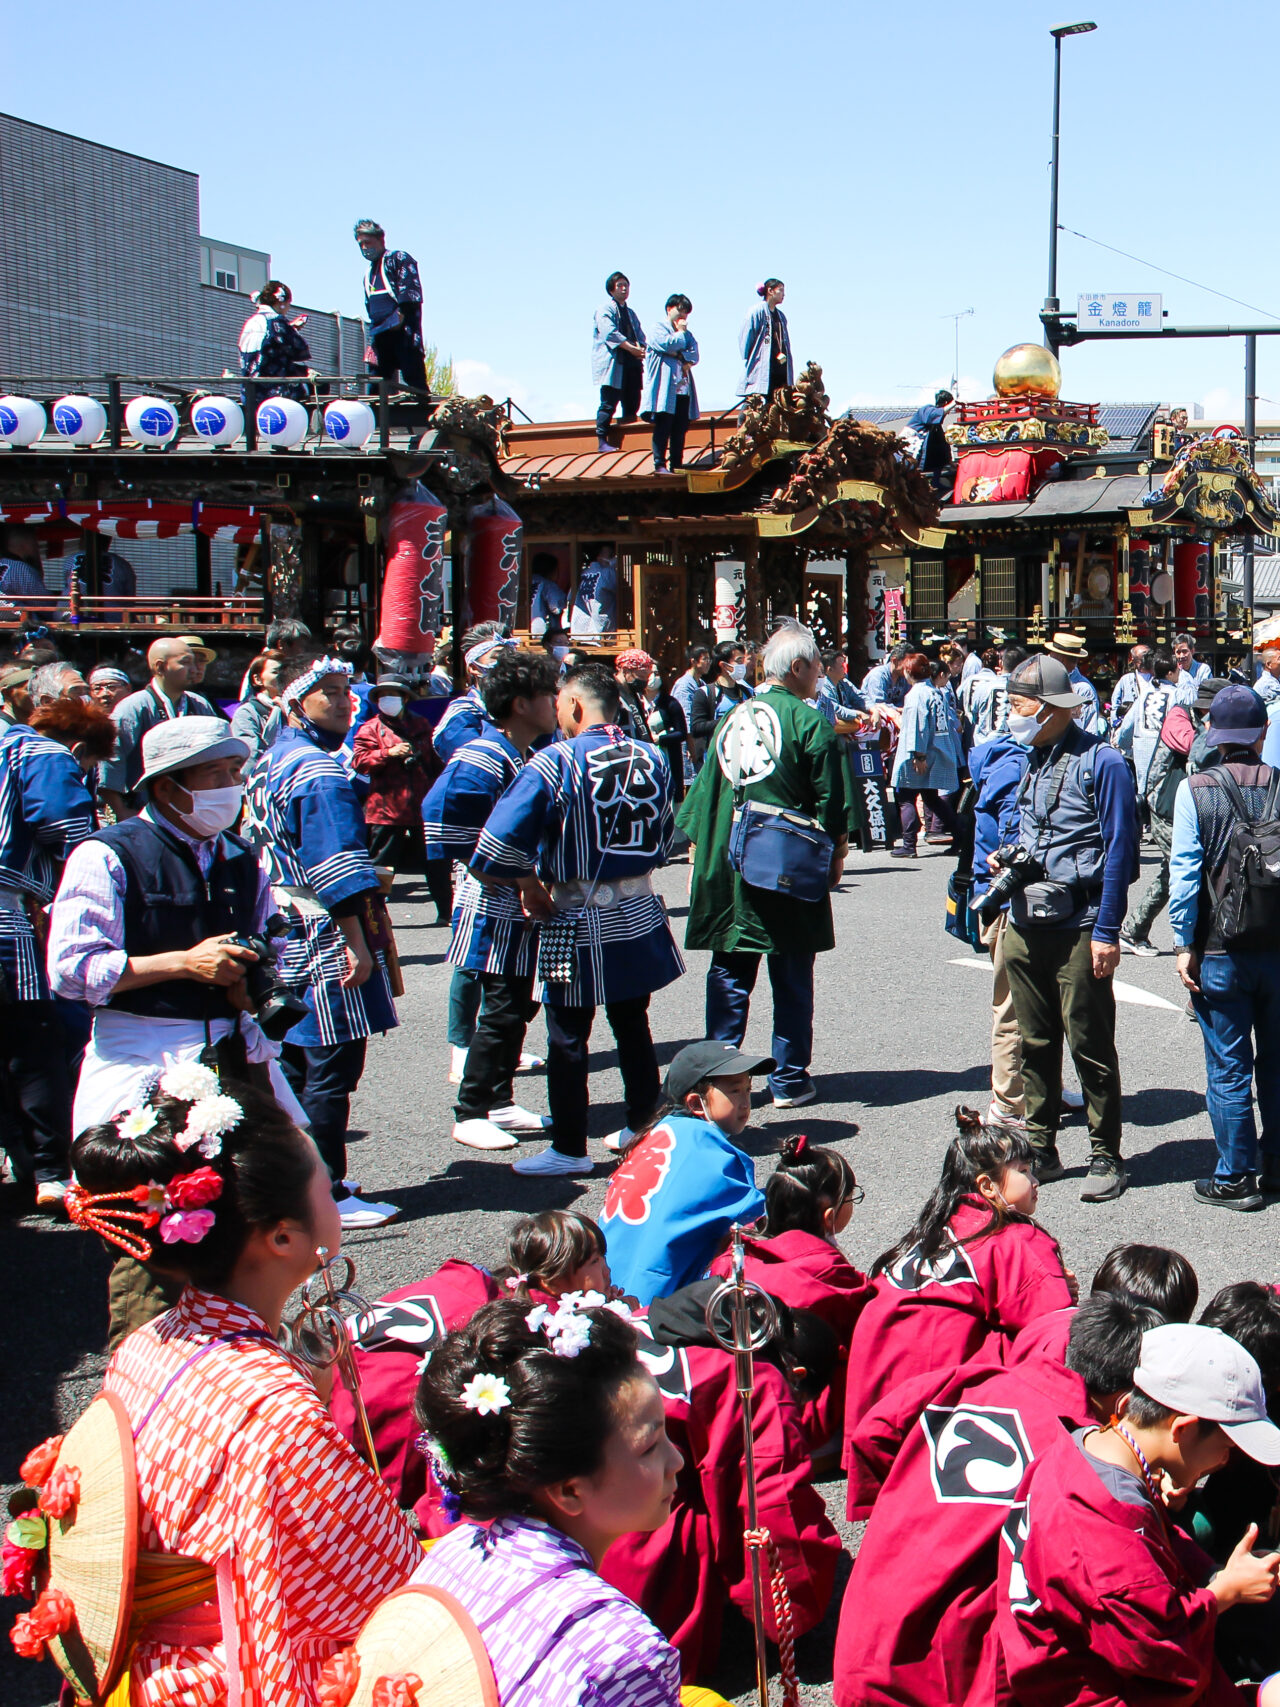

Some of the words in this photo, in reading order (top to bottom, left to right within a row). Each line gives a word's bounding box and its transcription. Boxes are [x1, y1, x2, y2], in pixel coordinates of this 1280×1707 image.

[1088, 301, 1152, 317] 金燈籠
[1099, 319, 1140, 327] Kanadoro
[863, 779, 887, 842] 大久保町
